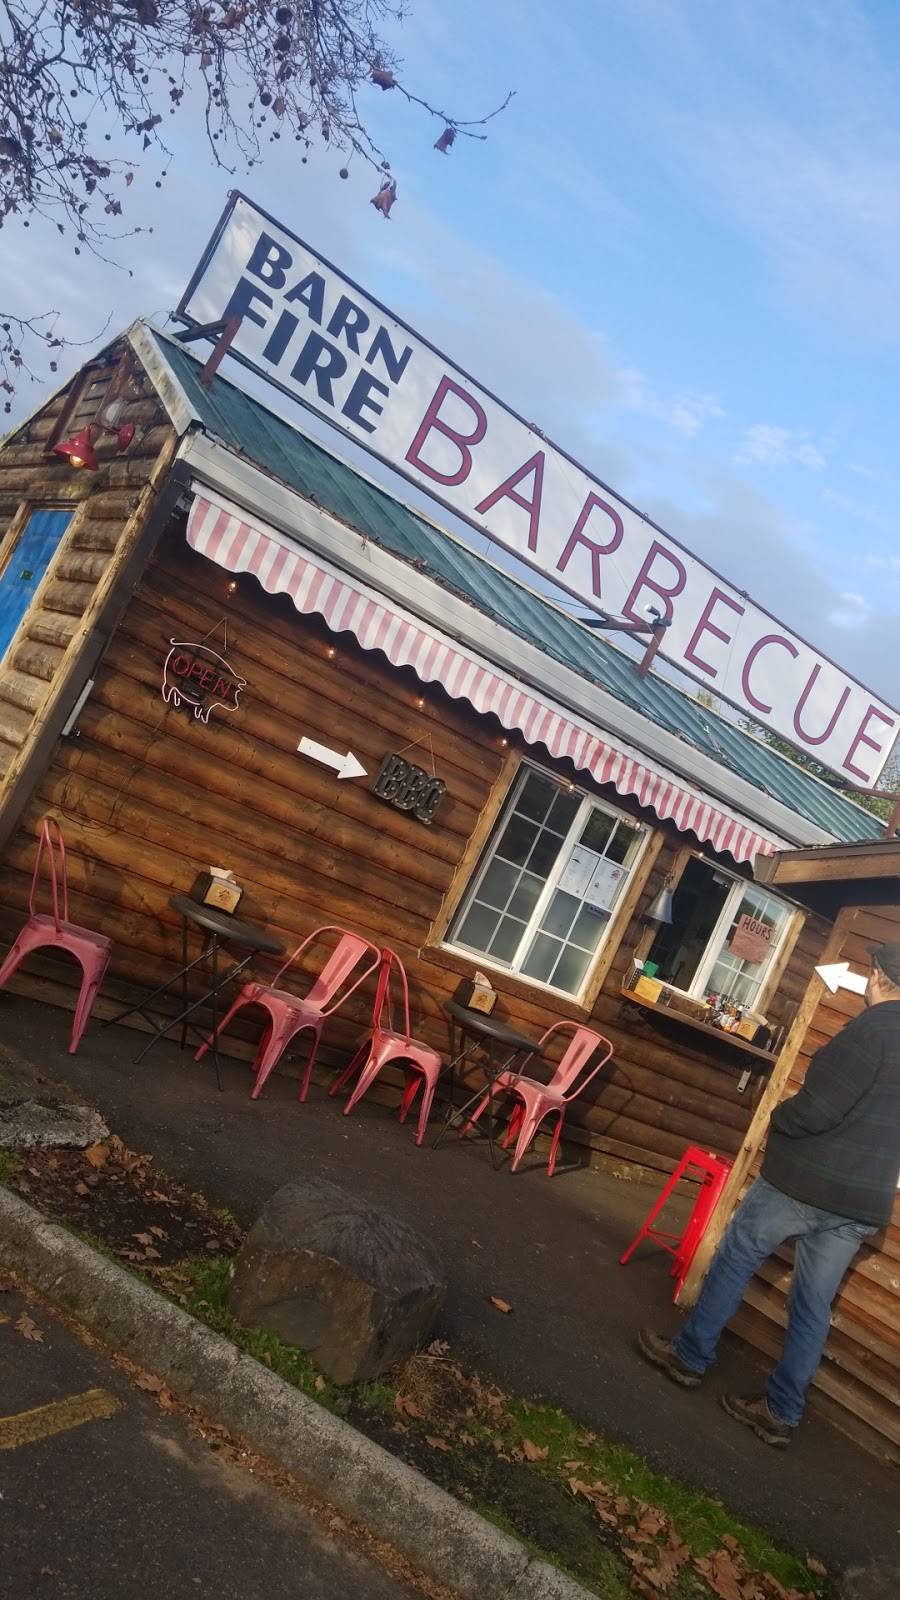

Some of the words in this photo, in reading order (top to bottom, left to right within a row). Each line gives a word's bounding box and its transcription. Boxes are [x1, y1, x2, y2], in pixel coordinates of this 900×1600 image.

[221, 276, 390, 434] FIRE
[246, 231, 413, 384] BARN
[405, 374, 895, 782] BARBECUE
[172, 655, 231, 698] OPEN
[373, 753, 447, 825] BBQ
[742, 917, 772, 941] HOURS
